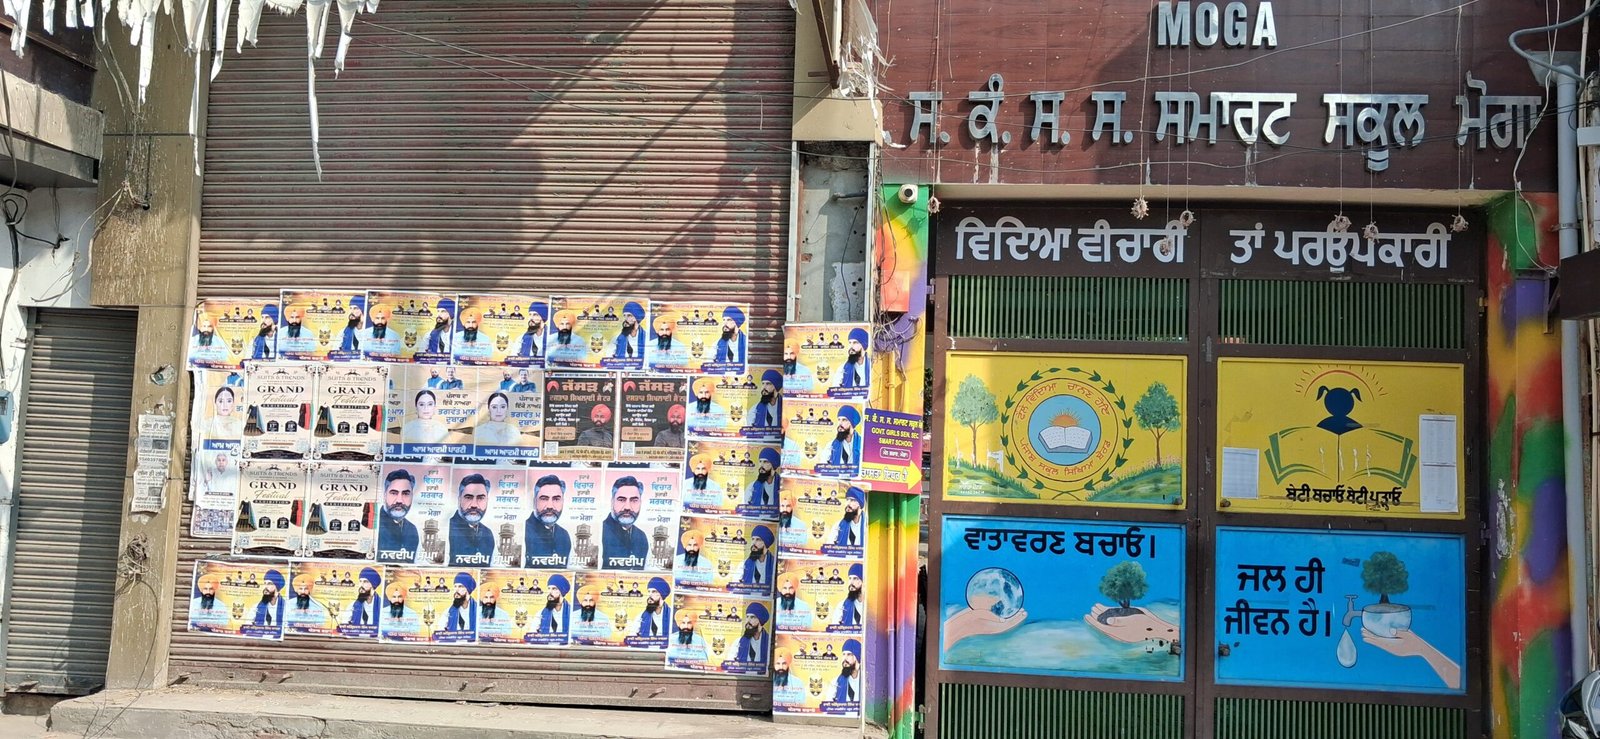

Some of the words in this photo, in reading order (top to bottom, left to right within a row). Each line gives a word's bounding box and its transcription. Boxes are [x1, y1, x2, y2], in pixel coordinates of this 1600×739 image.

[1157, 1, 1278, 47] MOGA
[909, 91, 951, 143] ਸ.
[968, 73, 1011, 144] ਕੰ.
[1030, 91, 1071, 144] ਸ.
[1091, 91, 1133, 144] ਸ.
[1155, 91, 1298, 145] ਸਮਾਰਟ
[1323, 94, 1429, 172] ਸਕੂਲ
[1455, 70, 1542, 149] ਮੋਗਾ
[955, 215, 1072, 261] ਵਿਦਿਆ
[1077, 218, 1187, 263] ਵੀਚਾਰੀ
[1229, 222, 1266, 264] ਤਾਂ
[1273, 222, 1452, 273] ਪਰਉਪਕਾਰੀ
[257, 385, 304, 394] GRAND
[327, 386, 376, 395] GRAND
[462, 408, 476, 416] ਮਾਨ
[885, 429, 900, 437] GIRLS
[878, 437, 895, 445] SMART
[895, 439, 913, 447] SCHOOL
[427, 445, 448, 453] ਆਦਮੀ
[448, 445, 467, 454] ਪਾਰਟੀ
[499, 448, 520, 456] ਆਦਮੀ
[520, 448, 539, 457] ਪਾਰਟੀ
[422, 474, 443, 485] ਵਿਚਾਰ
[497, 479, 519, 488] ਵਿਚਾਰ
[573, 480, 594, 489] ਵਿਚਾਰ
[249, 481, 297, 490] GRAND
[320, 483, 368, 492] GRAND
[650, 481, 672, 490] ਵਿਚਾਰ
[420, 491, 443, 499] ਸਰਕਾਰ
[1285, 483, 1311, 502] ਬੇਟੀ
[1312, 485, 1346, 503] ਬਚਾਓ
[1346, 486, 1368, 505] ਬੇਟੀ
[648, 497, 673, 505] ਸਰਕਾਰ
[963, 527, 1066, 555] ਵਾਤਾਵਰਣ
[379, 547, 414, 560] ਨਵਦੀਪ
[455, 551, 490, 564] ਨਵਦੀਪ
[531, 553, 567, 565] ਨਵਦੀਪ
[608, 554, 644, 566] ਨਵਦੀਪ
[1237, 563, 1286, 593] ਜਲ
[1294, 556, 1326, 594] ਹੀ
[1223, 598, 1290, 636] ਜੀਵਨ
